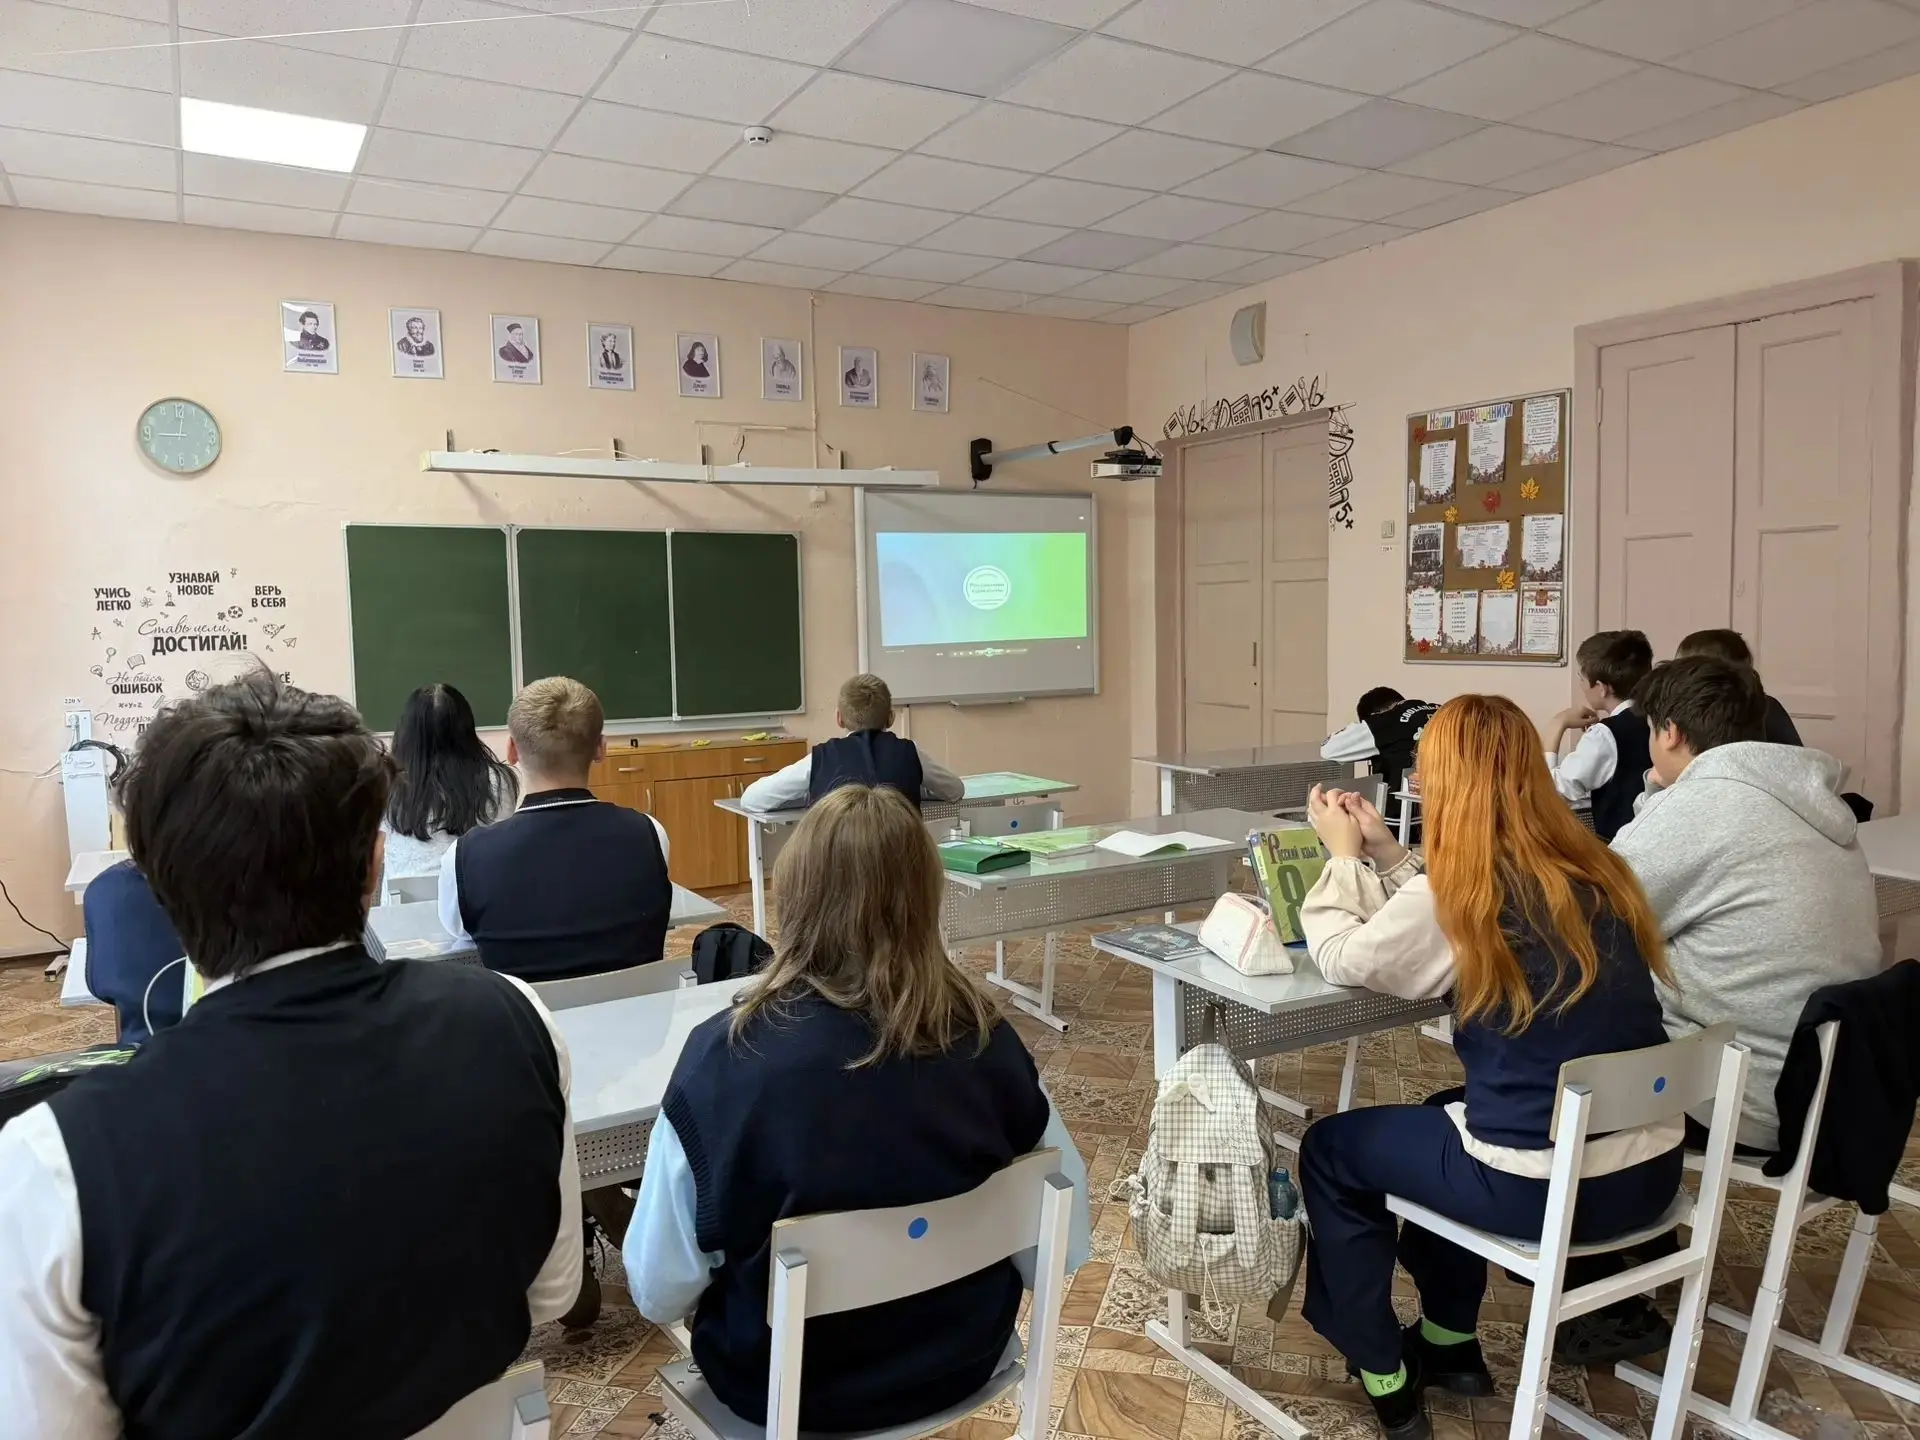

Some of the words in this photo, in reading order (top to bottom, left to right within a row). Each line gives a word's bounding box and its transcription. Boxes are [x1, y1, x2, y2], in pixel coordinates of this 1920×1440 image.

[174, 403, 184, 418] 12
[1430, 412, 1452, 430] Наши
[144, 426, 151, 440] 9
[178, 453, 184, 466] 6
[169, 571, 220, 583] УЗНАВАЙ
[94, 587, 131, 599] УЧИСЬ
[177, 585, 214, 596] НОВОЕ
[254, 585, 282, 596] ВЕРЬ
[96, 600, 131, 611] ЛЕГКО
[251, 598, 258, 608] В
[260, 597, 286, 608] СЕБЯ
[1528, 607, 1557, 615] ГРАМОТА
[138, 614, 191, 636] Ставь
[193, 624, 231, 634] цели,
[152, 632, 248, 656] ДОСТИГАЙ!
[106, 672, 130, 685] Не
[132, 672, 164, 682] бойся
[112, 683, 163, 694] ОШИБОК
[1268, 833, 1300, 864] Русский
[1300, 846, 1319, 859] язык
